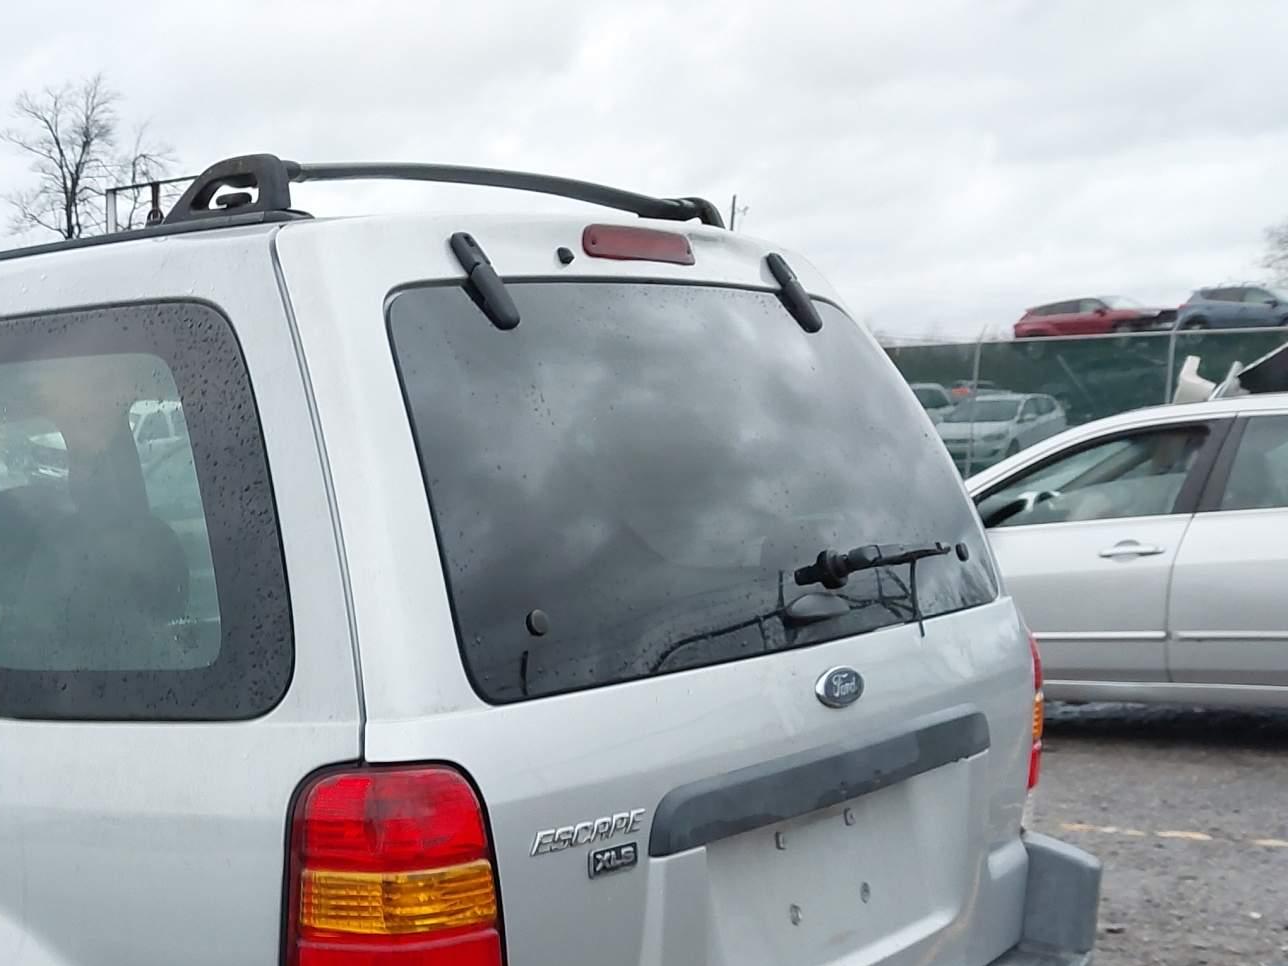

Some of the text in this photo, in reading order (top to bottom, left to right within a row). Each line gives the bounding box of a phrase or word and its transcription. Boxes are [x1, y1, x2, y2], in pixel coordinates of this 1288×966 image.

[832, 673, 857, 698] Ford
[530, 808, 646, 856] ESCAPE
[594, 846, 635, 873] XLS
